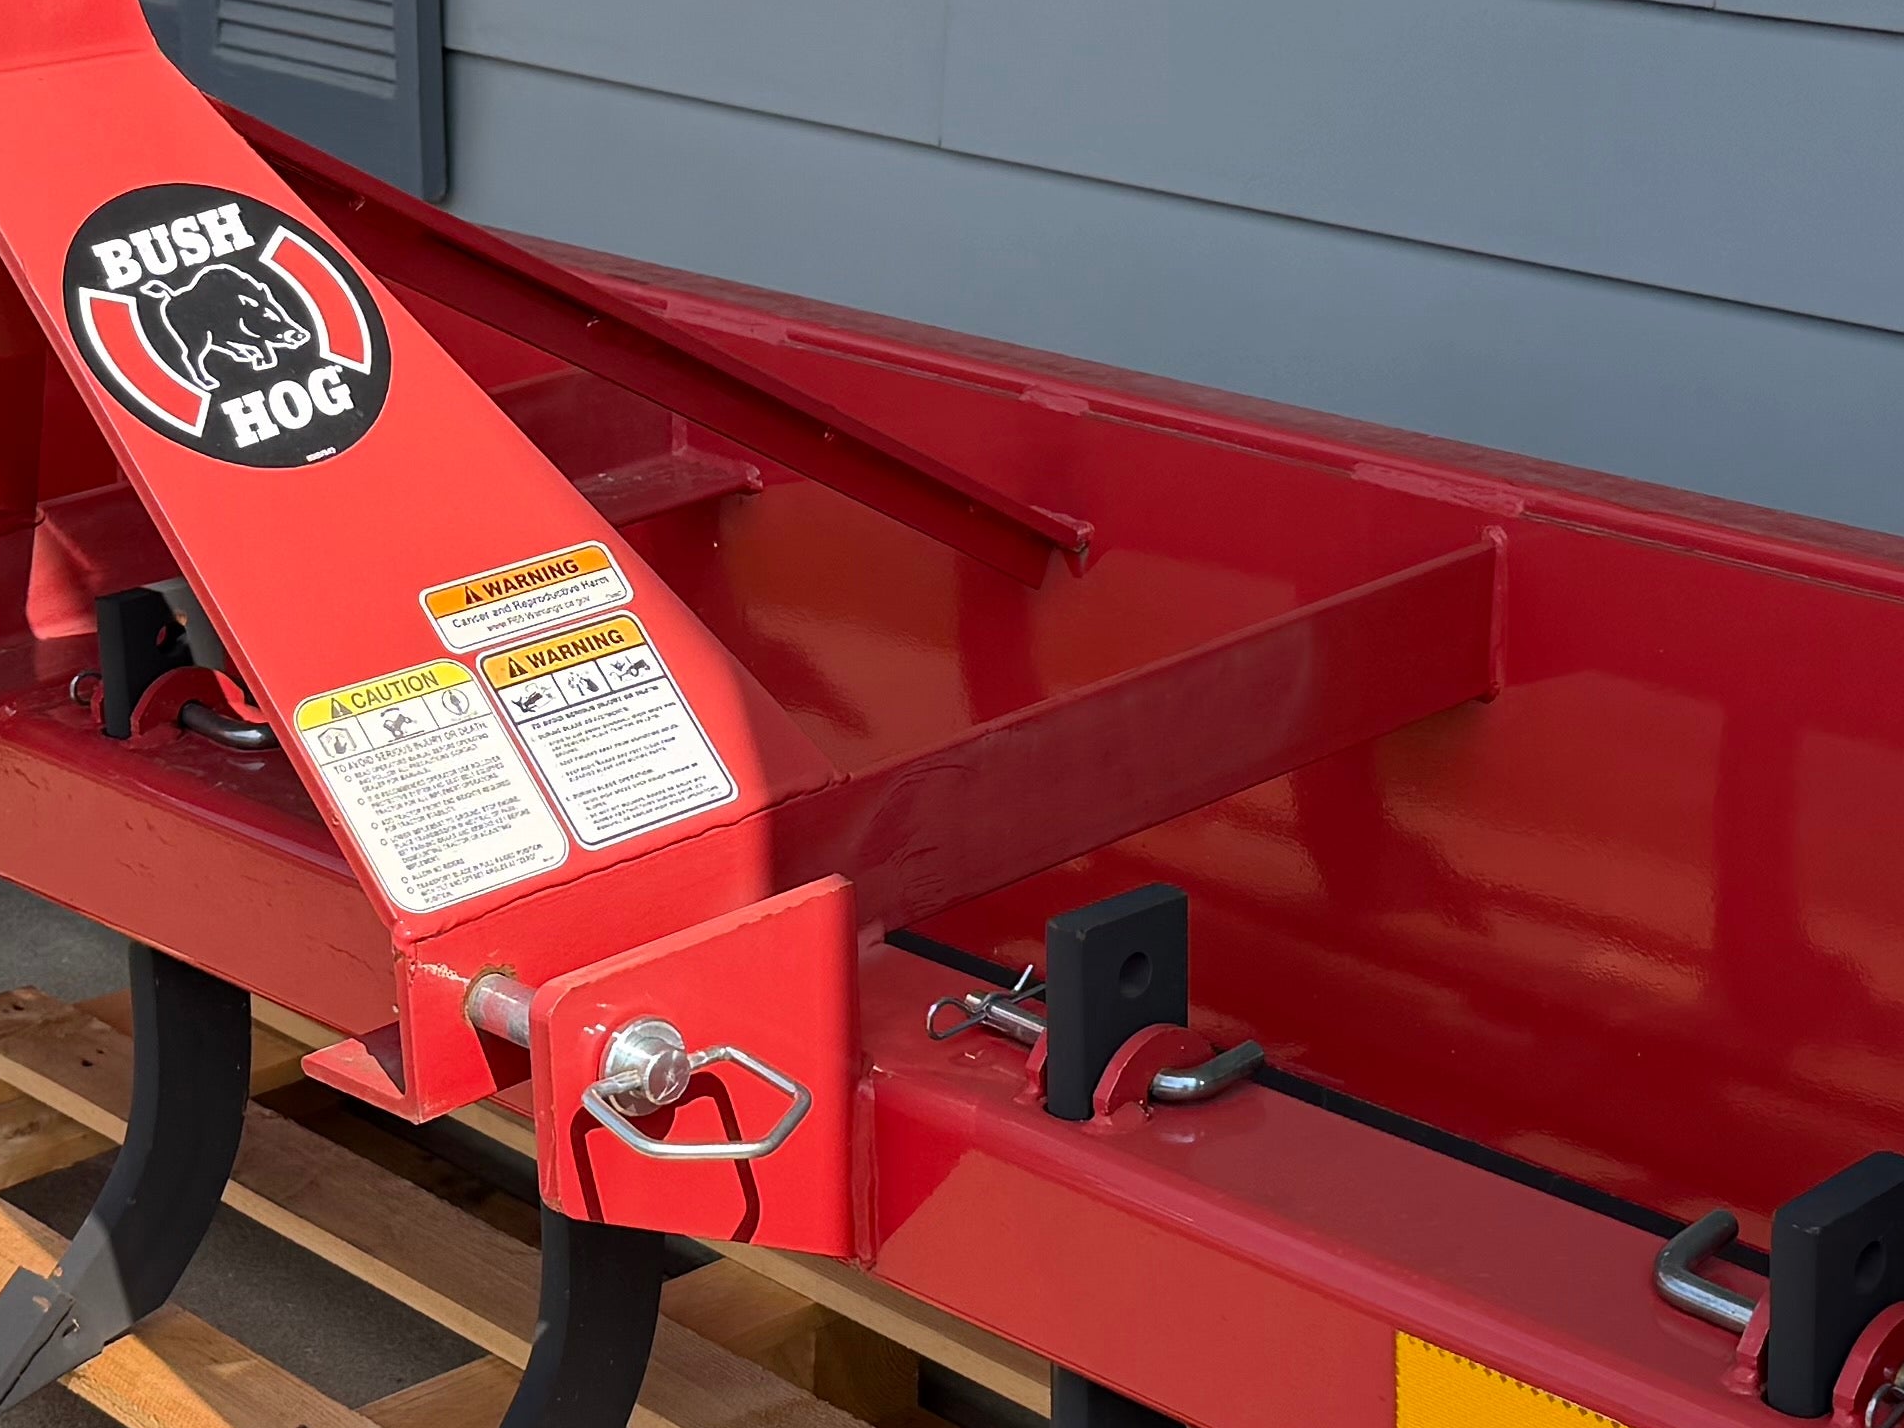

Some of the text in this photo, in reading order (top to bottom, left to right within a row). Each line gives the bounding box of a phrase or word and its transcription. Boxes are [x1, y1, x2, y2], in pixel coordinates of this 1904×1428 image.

[91, 202, 256, 290] BUSH
[220, 364, 355, 448] HOG
[482, 558, 580, 599] WARNING
[492, 603, 512, 617] and
[525, 628, 625, 669] WARNING
[350, 670, 440, 709] CAUTION
